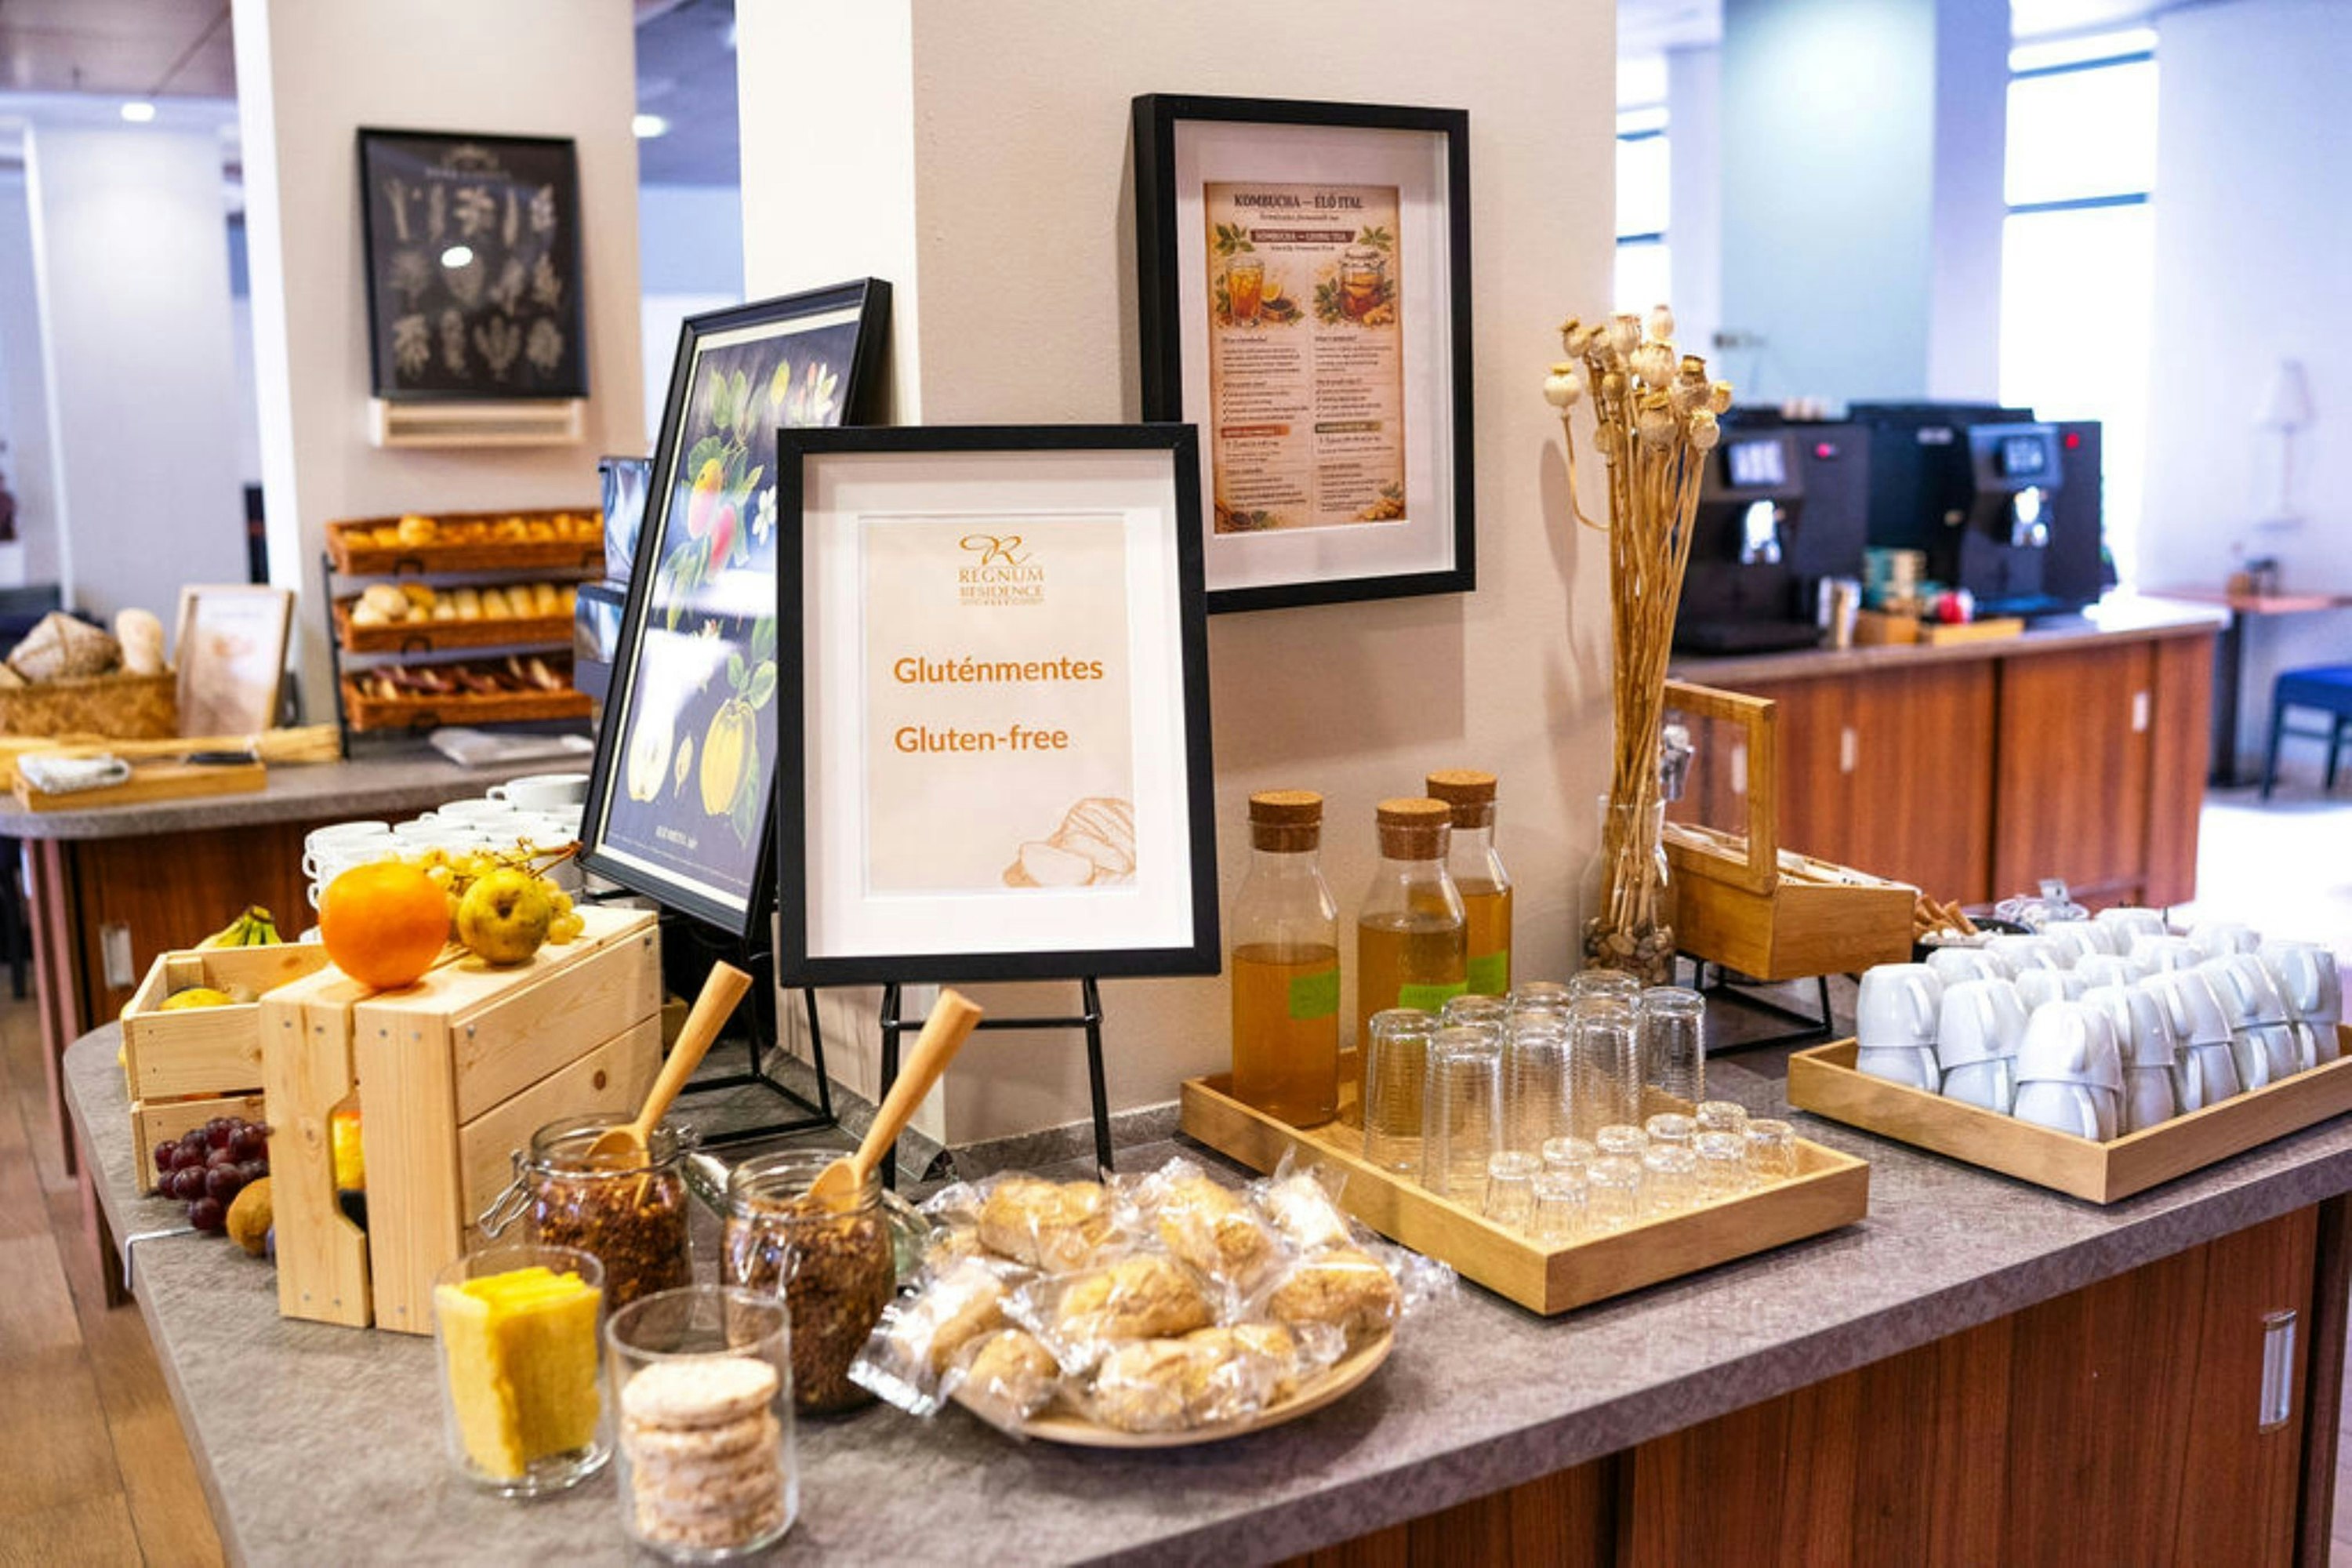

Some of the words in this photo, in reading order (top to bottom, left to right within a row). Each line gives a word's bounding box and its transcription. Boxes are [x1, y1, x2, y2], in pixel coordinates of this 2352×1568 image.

[958, 568, 1044, 583] REGNUM
[894, 656, 1104, 684] Gluténmentes
[895, 725, 1069, 753] Gluten-free
